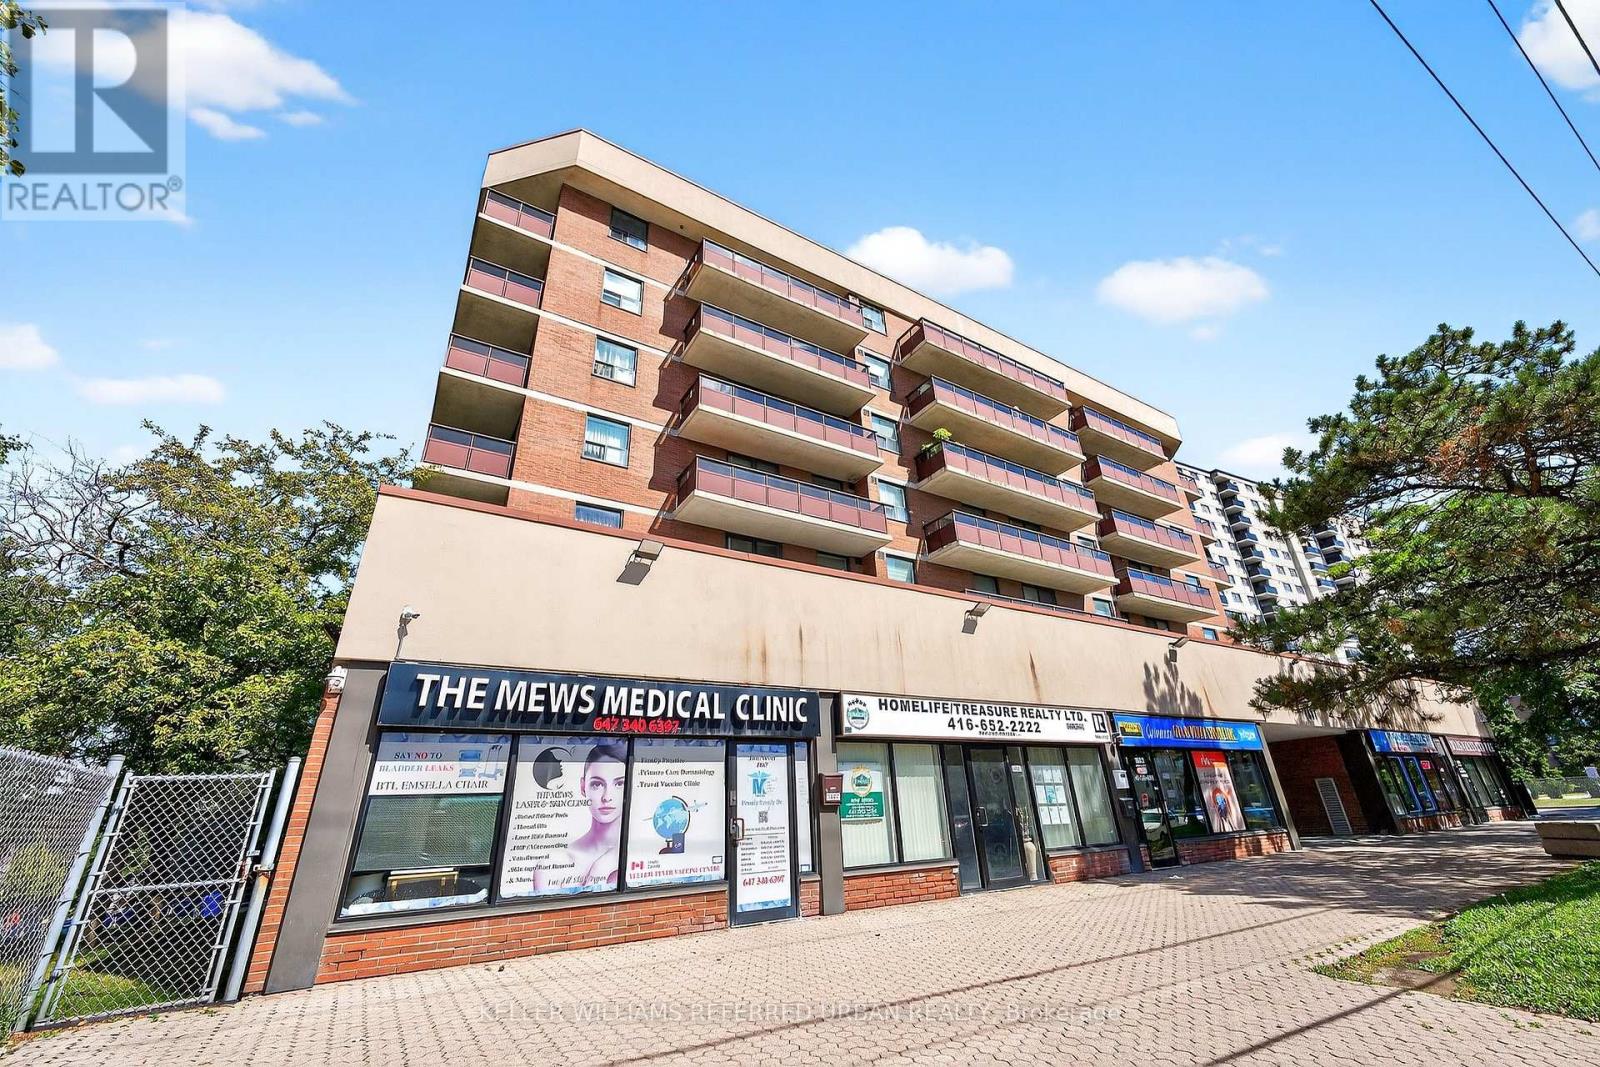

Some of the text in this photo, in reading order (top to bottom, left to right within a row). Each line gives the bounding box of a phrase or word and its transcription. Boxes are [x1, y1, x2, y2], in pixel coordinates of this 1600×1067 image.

[416, 673, 808, 723] THE MEWS MEDICAL CLINIC
[879, 698, 1018, 718] HOMELIFE/TREASURE
[1020, 707, 1061, 721] REALTY
[1064, 710, 1088, 722] LTD.
[593, 717, 618, 732] 647
[622, 717, 645, 733] 340
[947, 717, 1042, 733] 416-652-2222
[425, 764, 454, 772] LEAKS
[401, 780, 453, 790] EMSELLA
[455, 780, 488, 789] CHAIR
